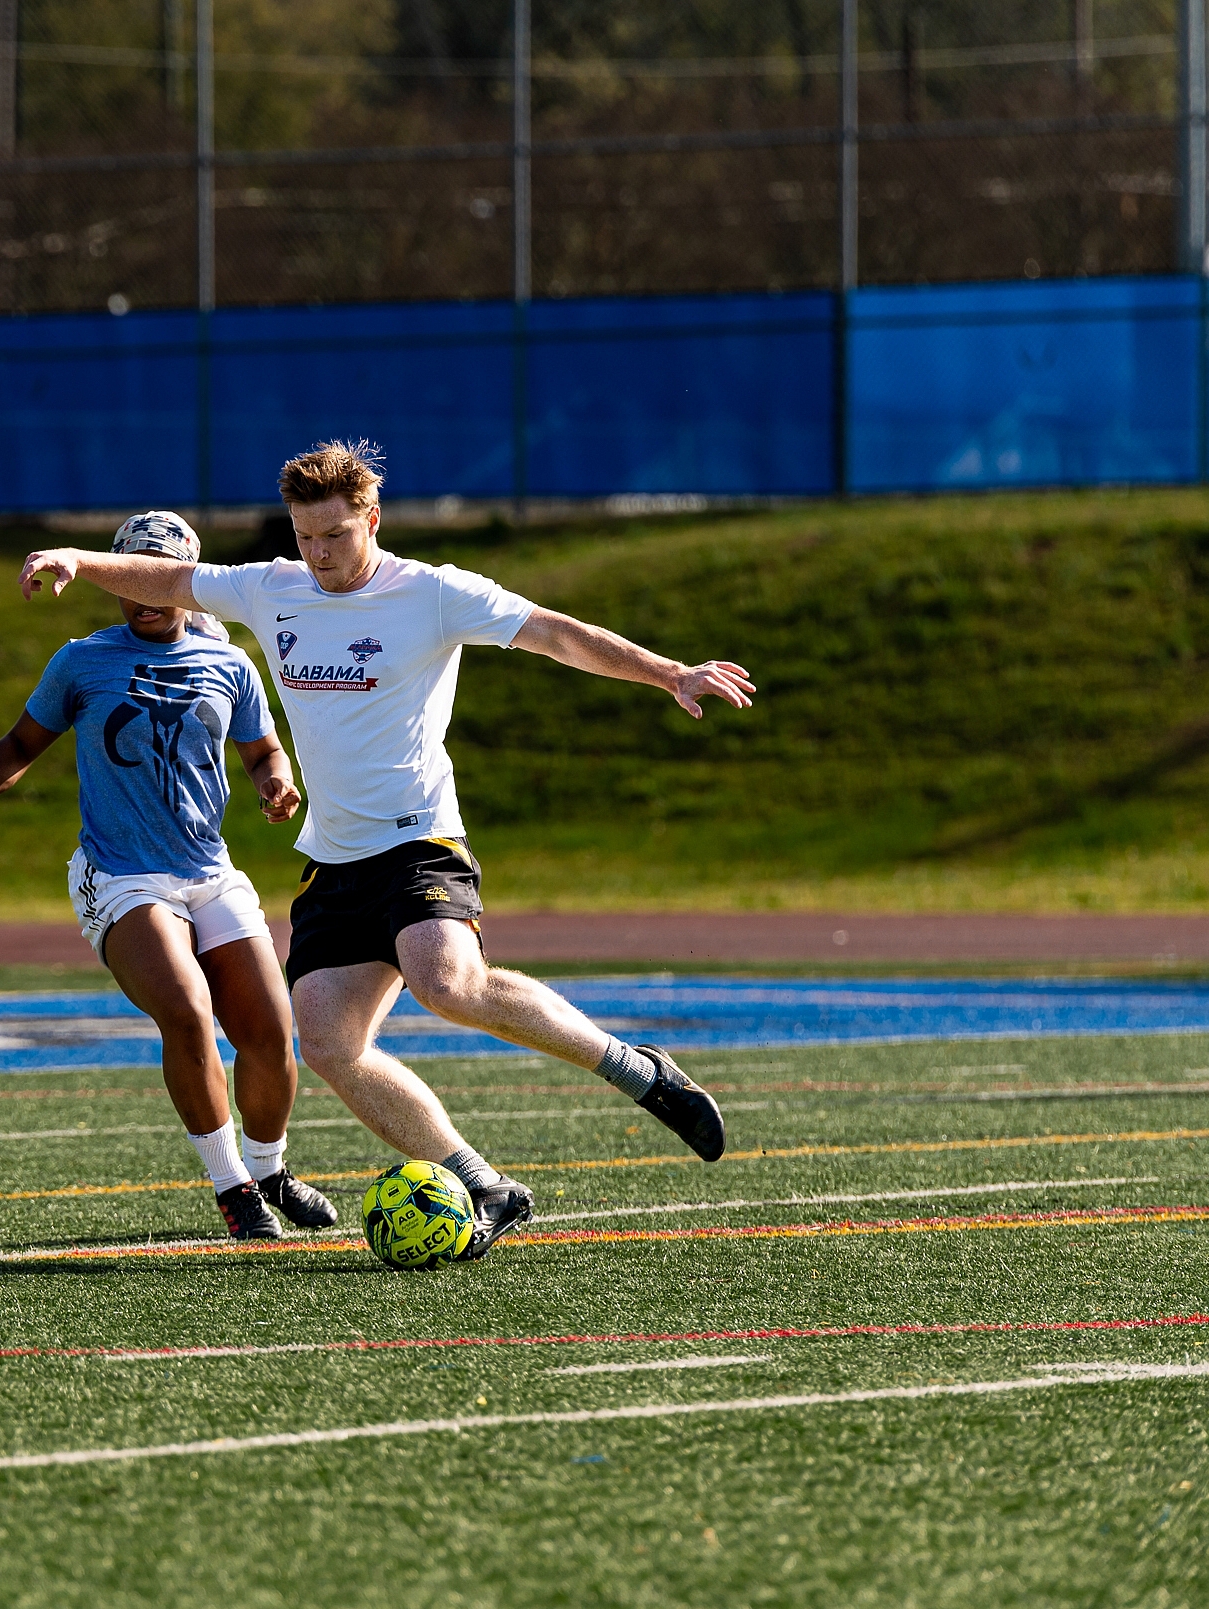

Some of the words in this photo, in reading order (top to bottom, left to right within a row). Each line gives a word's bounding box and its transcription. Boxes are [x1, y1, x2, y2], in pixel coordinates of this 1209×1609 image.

[283, 664, 365, 681] ALABAMA
[398, 1210, 416, 1225] AG
[396, 1222, 451, 1262] SELECT
